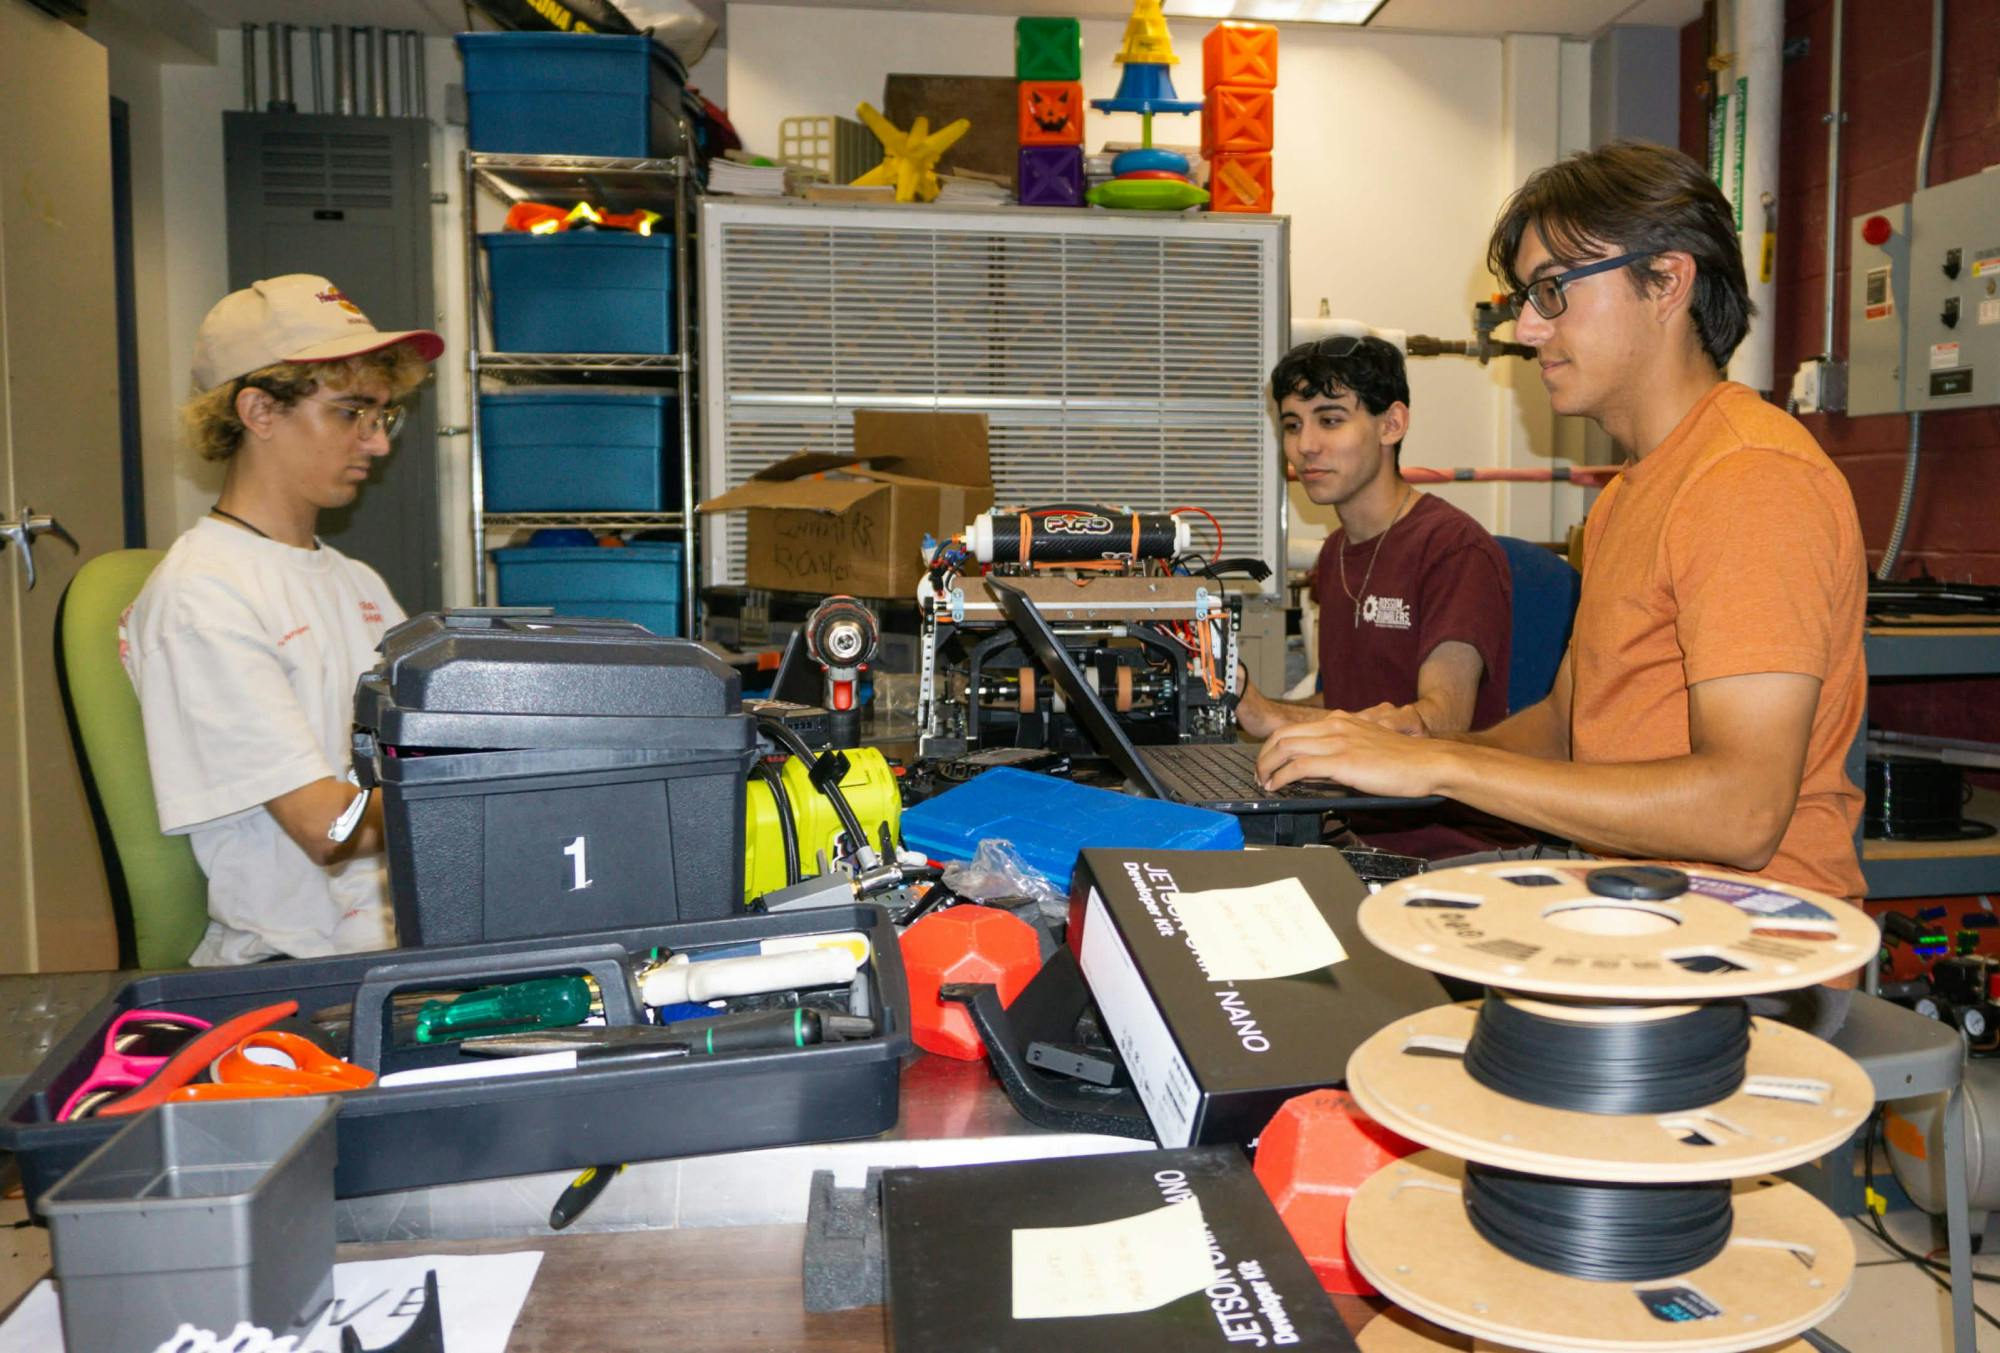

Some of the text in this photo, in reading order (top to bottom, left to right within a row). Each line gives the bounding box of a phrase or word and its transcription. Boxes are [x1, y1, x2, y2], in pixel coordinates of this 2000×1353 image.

[564, 836, 593, 892] 1
[1123, 861, 1176, 937] Developer Kit
[1215, 990, 1271, 1053] NANO
[1237, 1259, 1300, 1345] Developer Kit
